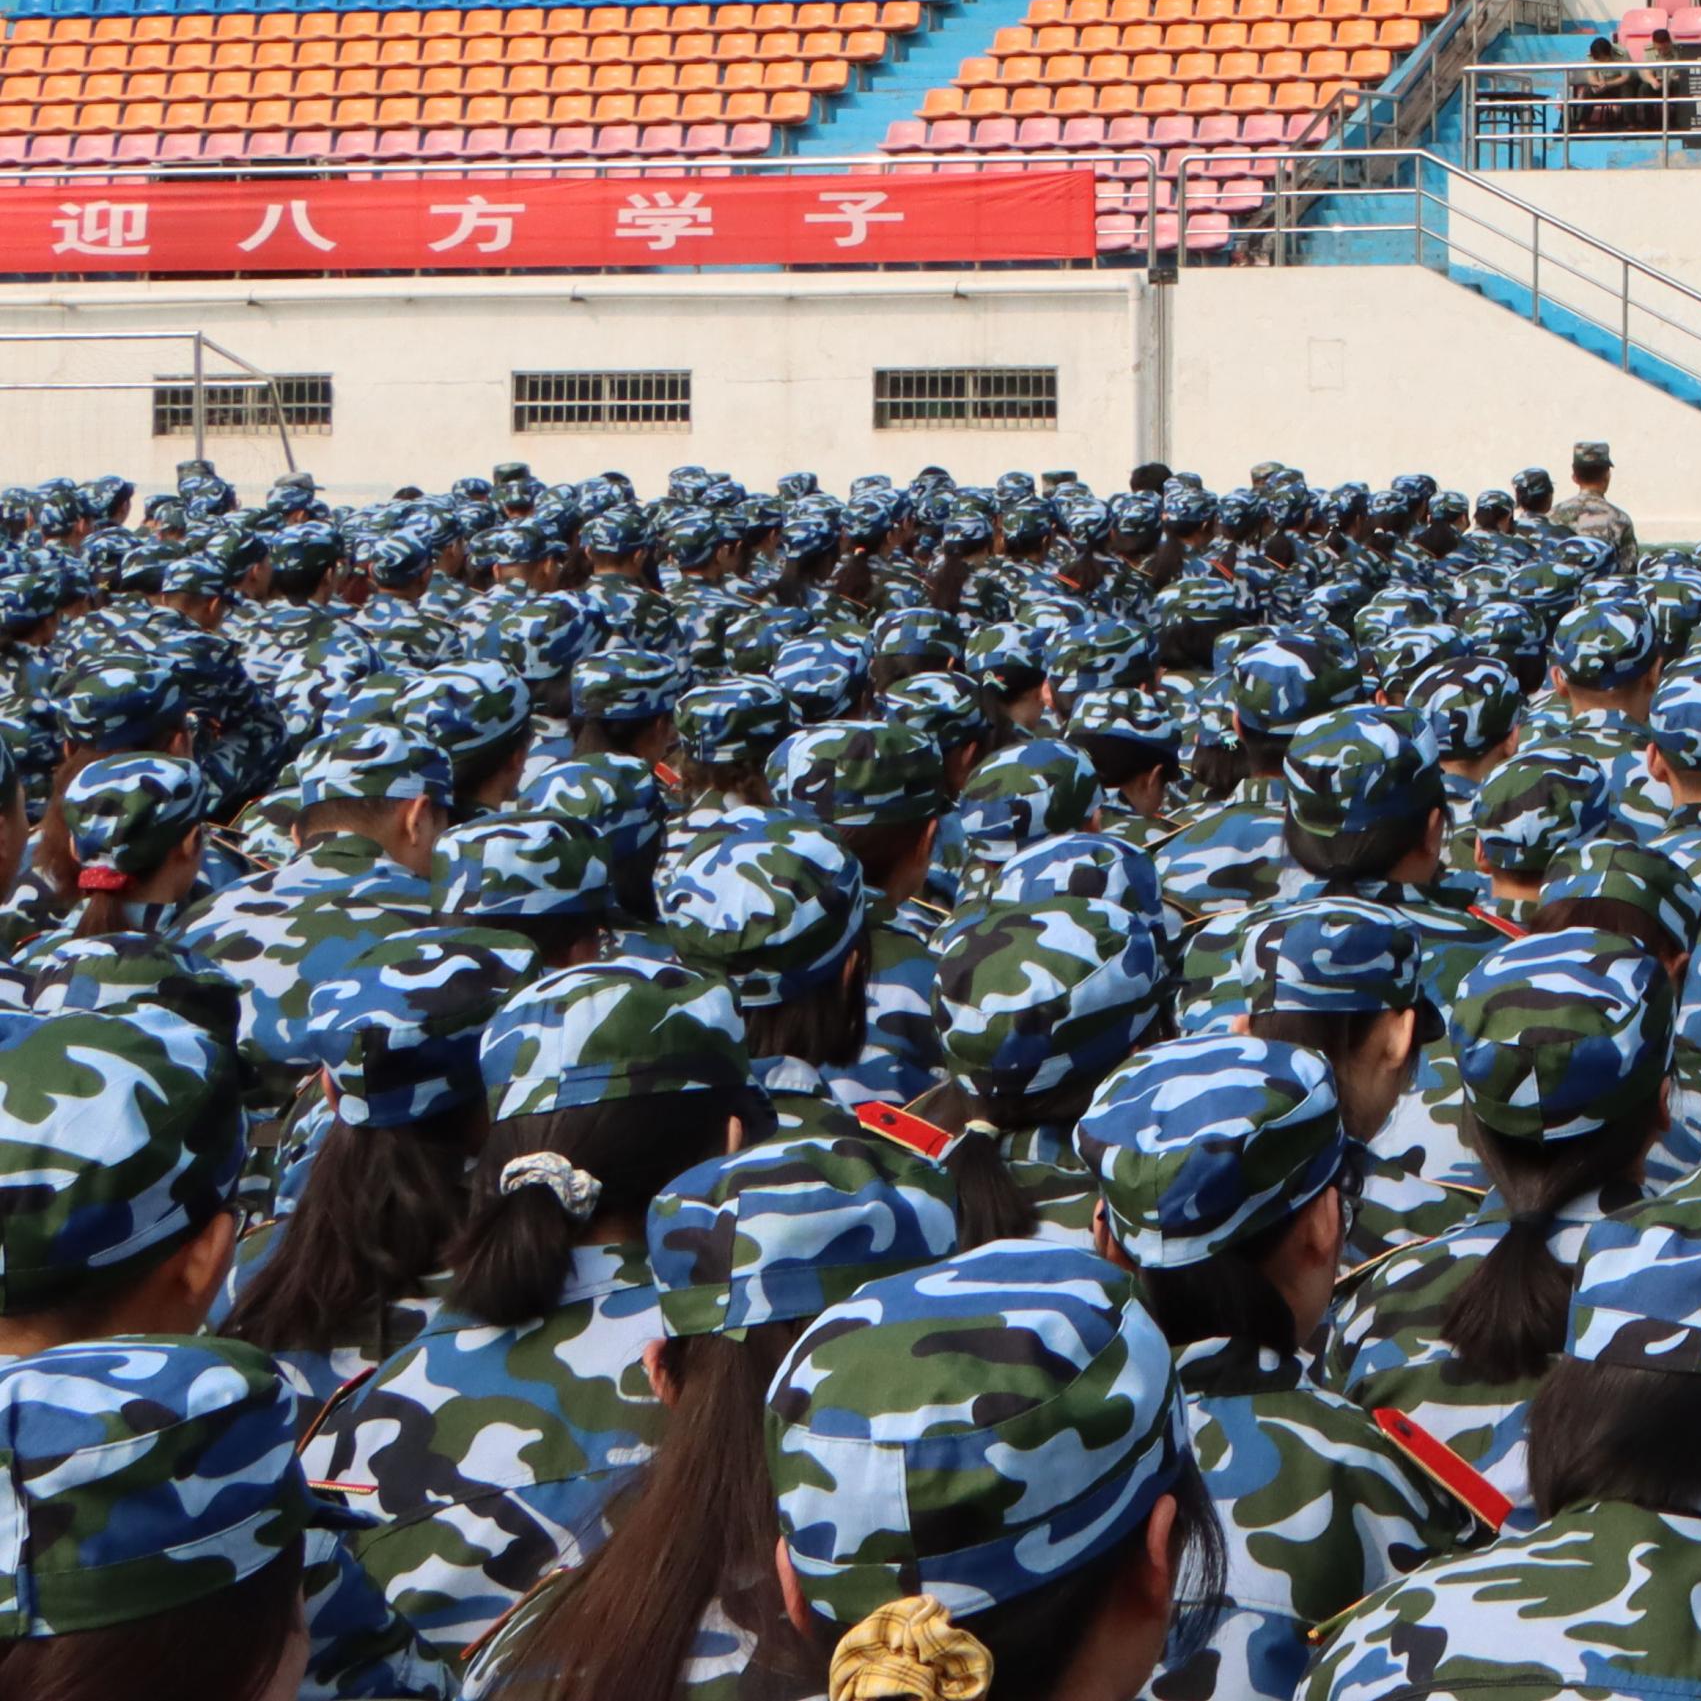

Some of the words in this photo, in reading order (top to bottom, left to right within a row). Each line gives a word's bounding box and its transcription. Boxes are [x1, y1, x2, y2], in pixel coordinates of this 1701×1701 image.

[51, 191, 904, 256] 迎八方学子
